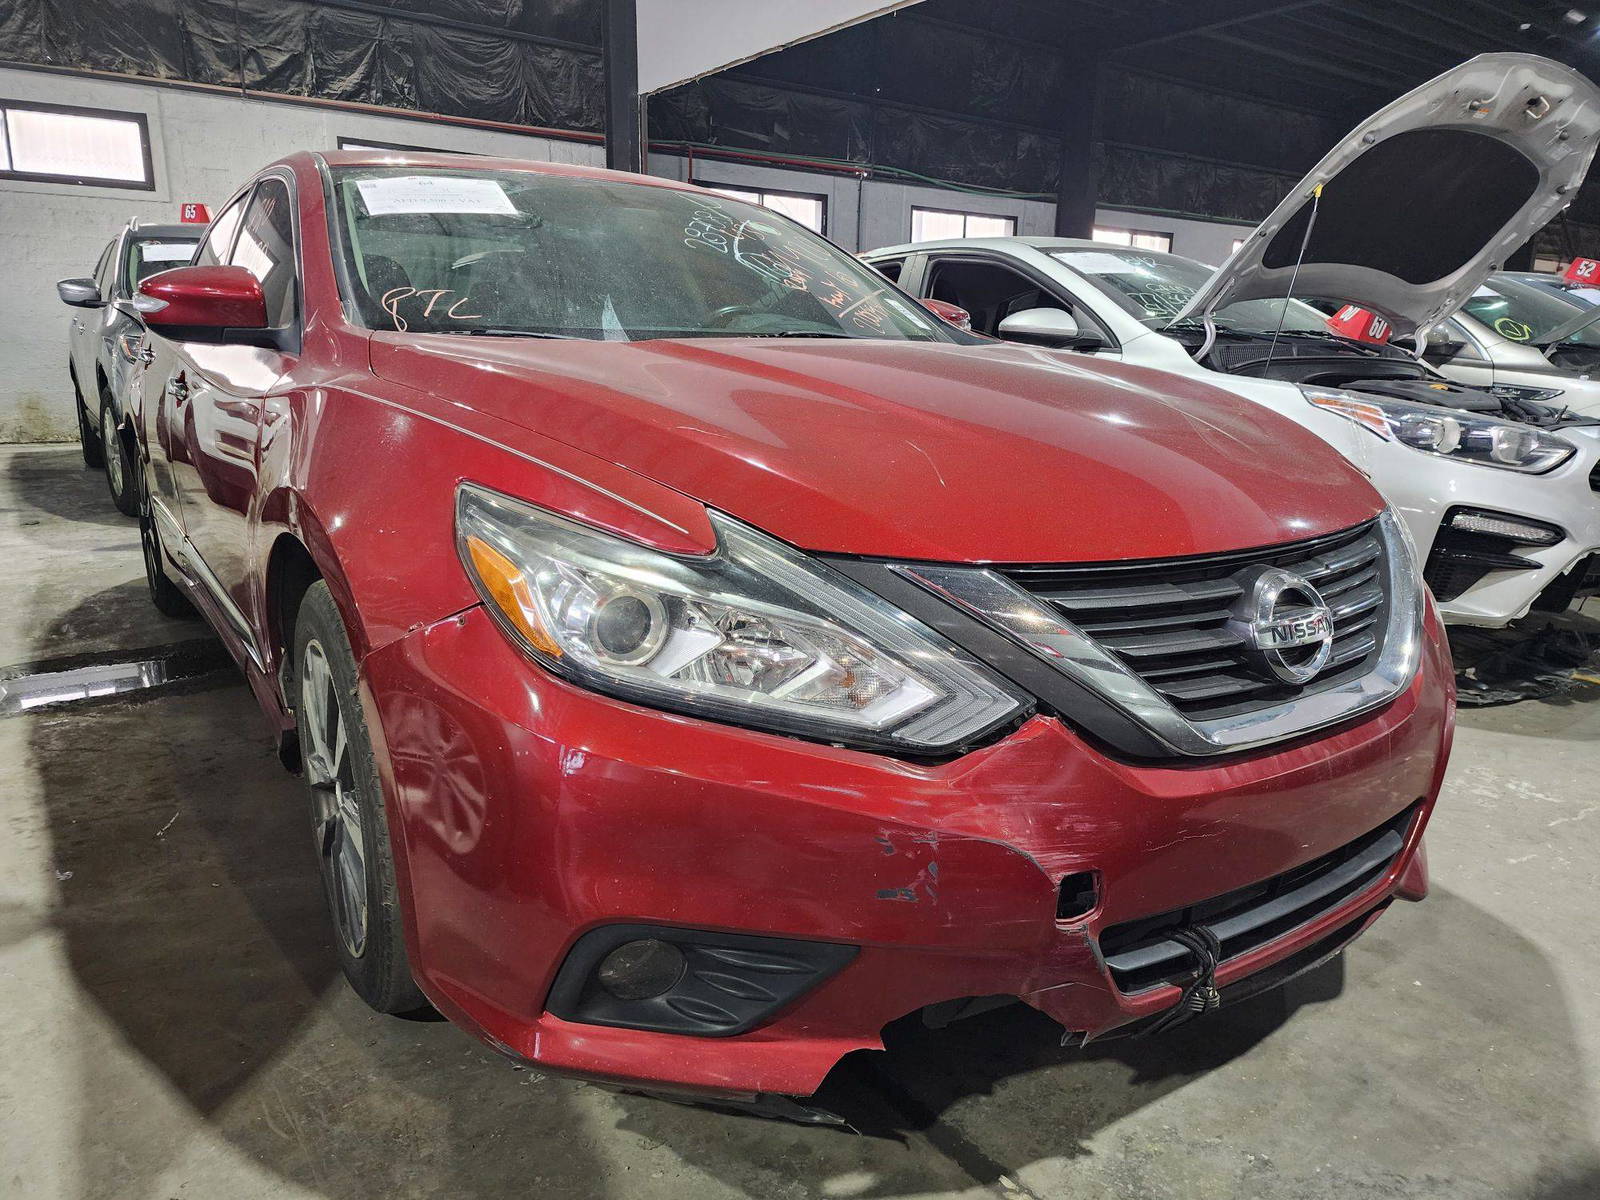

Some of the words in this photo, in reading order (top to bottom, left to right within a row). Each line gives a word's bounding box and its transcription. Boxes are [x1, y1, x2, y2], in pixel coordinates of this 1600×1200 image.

[185, 204, 196, 219] 65
[1576, 260, 1597, 277] 52
[1271, 615, 1332, 643] NISSAN
